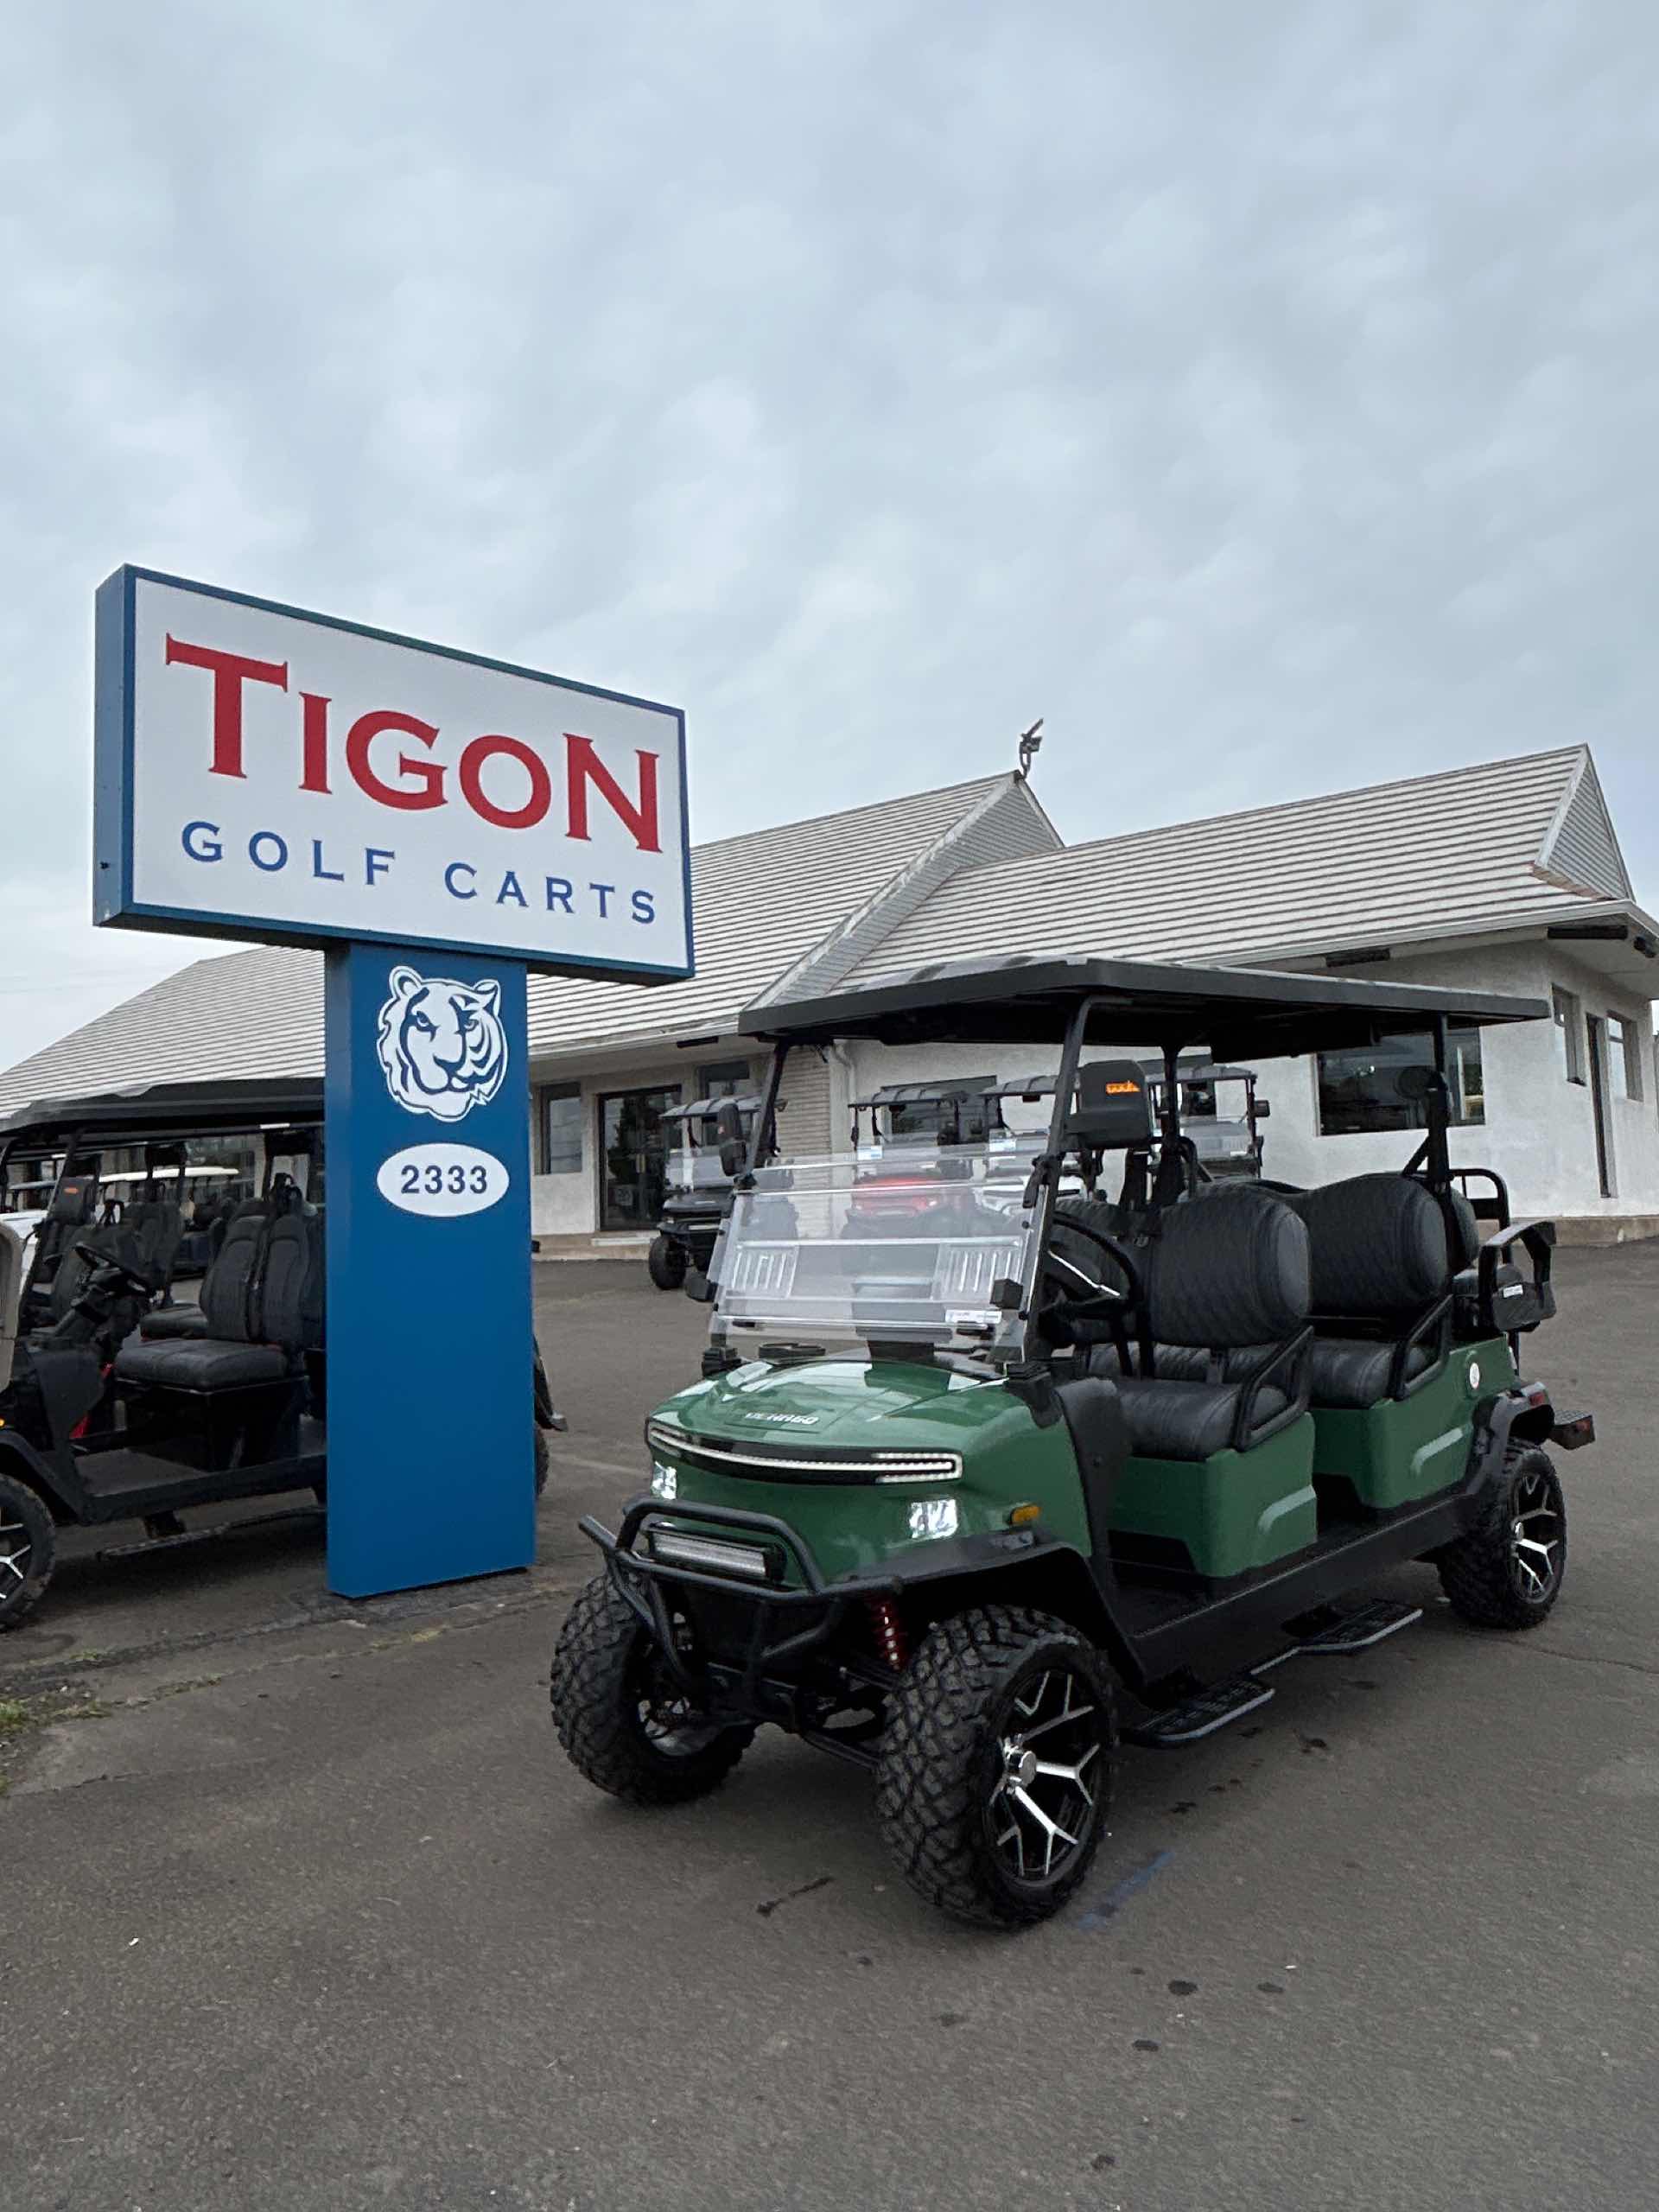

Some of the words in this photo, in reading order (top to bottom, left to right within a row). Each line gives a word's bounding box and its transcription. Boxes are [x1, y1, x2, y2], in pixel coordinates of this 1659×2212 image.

[165, 632, 663, 854] TIGON
[181, 820, 395, 886] GOLF
[444, 861, 657, 925] CARTS
[400, 1164, 487, 1194] 2333
